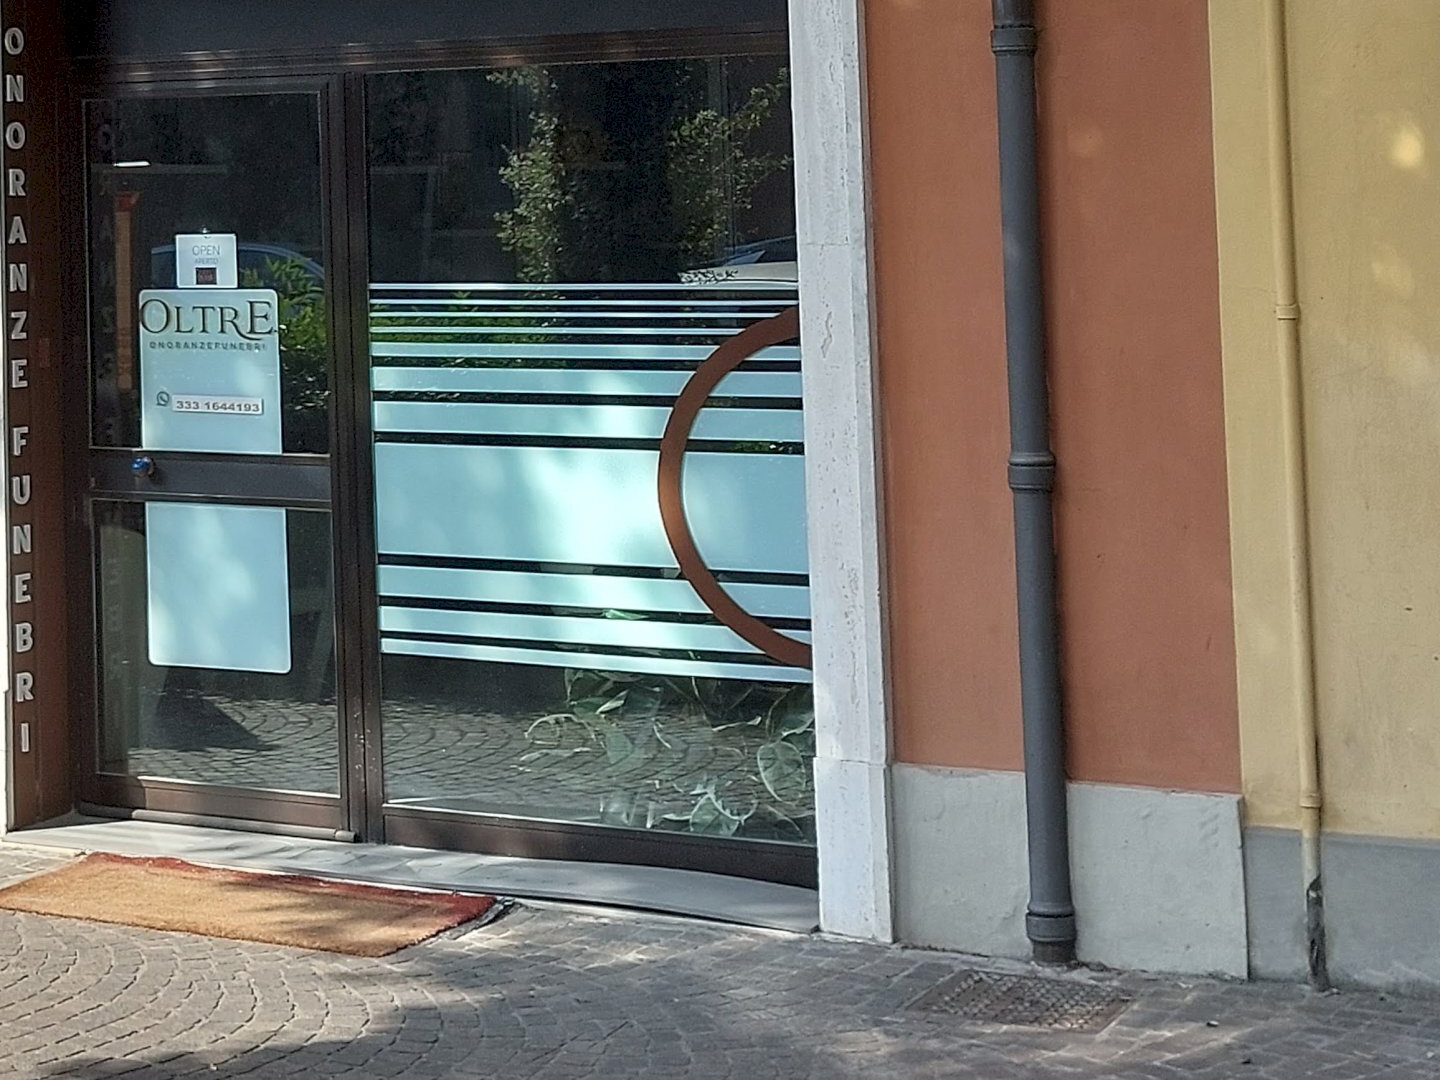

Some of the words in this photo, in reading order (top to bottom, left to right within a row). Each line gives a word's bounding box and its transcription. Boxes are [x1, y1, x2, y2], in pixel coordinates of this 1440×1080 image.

[4, 27, 28, 388] ONORANZE
[191, 245, 220, 256] OPEN
[176, 400, 200, 410] 333
[204, 401, 260, 413] 1644193
[12, 427, 34, 753] FUNEBRI
